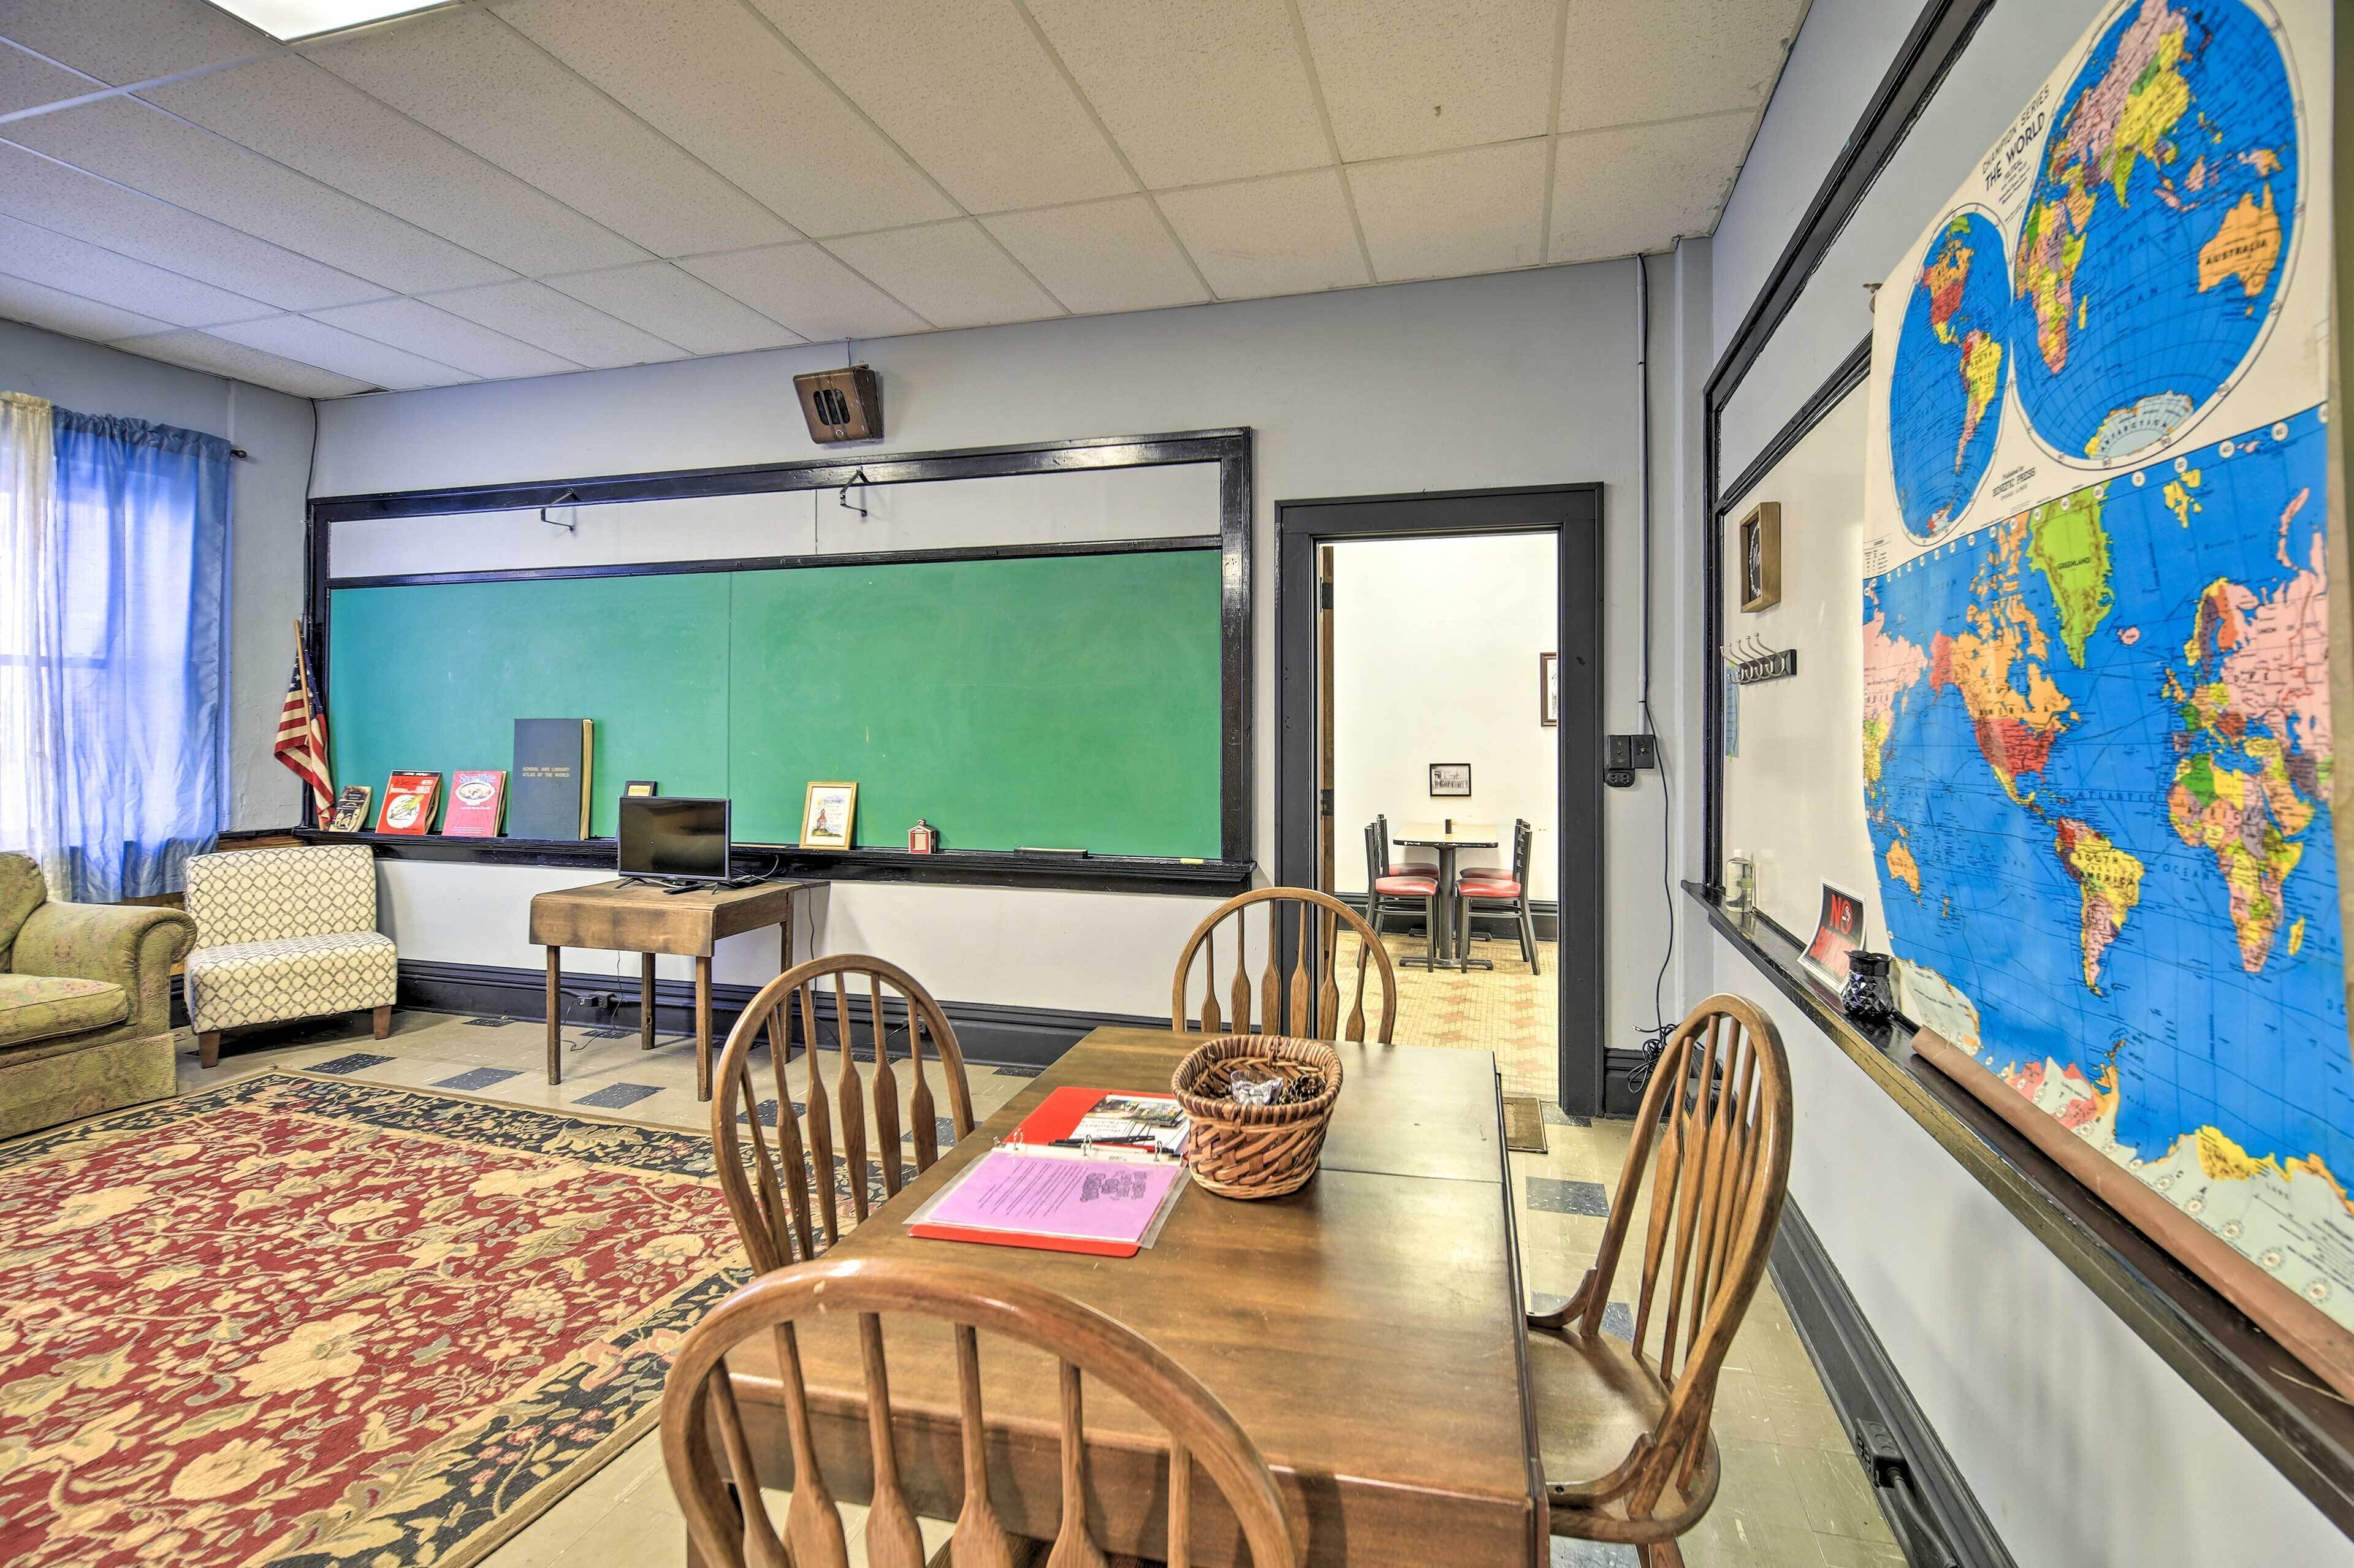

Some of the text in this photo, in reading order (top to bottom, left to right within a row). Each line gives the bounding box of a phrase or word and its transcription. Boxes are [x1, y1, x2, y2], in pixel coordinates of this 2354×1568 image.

[2021, 84, 2049, 126] SERIES
[1986, 160, 2002, 191] THE
[2006, 111, 2044, 164] WORLD
[2206, 240, 2267, 265] AUSTRALIA
[2101, 419, 2168, 452] ANTARCTICA
[2057, 557, 2090, 570] GREENLAND
[2077, 790, 2157, 803] ATLANTIC
[2076, 853, 2119, 864] SOUTH
[2162, 863, 2210, 881] OCEAN
[1829, 893, 1853, 935] NO
